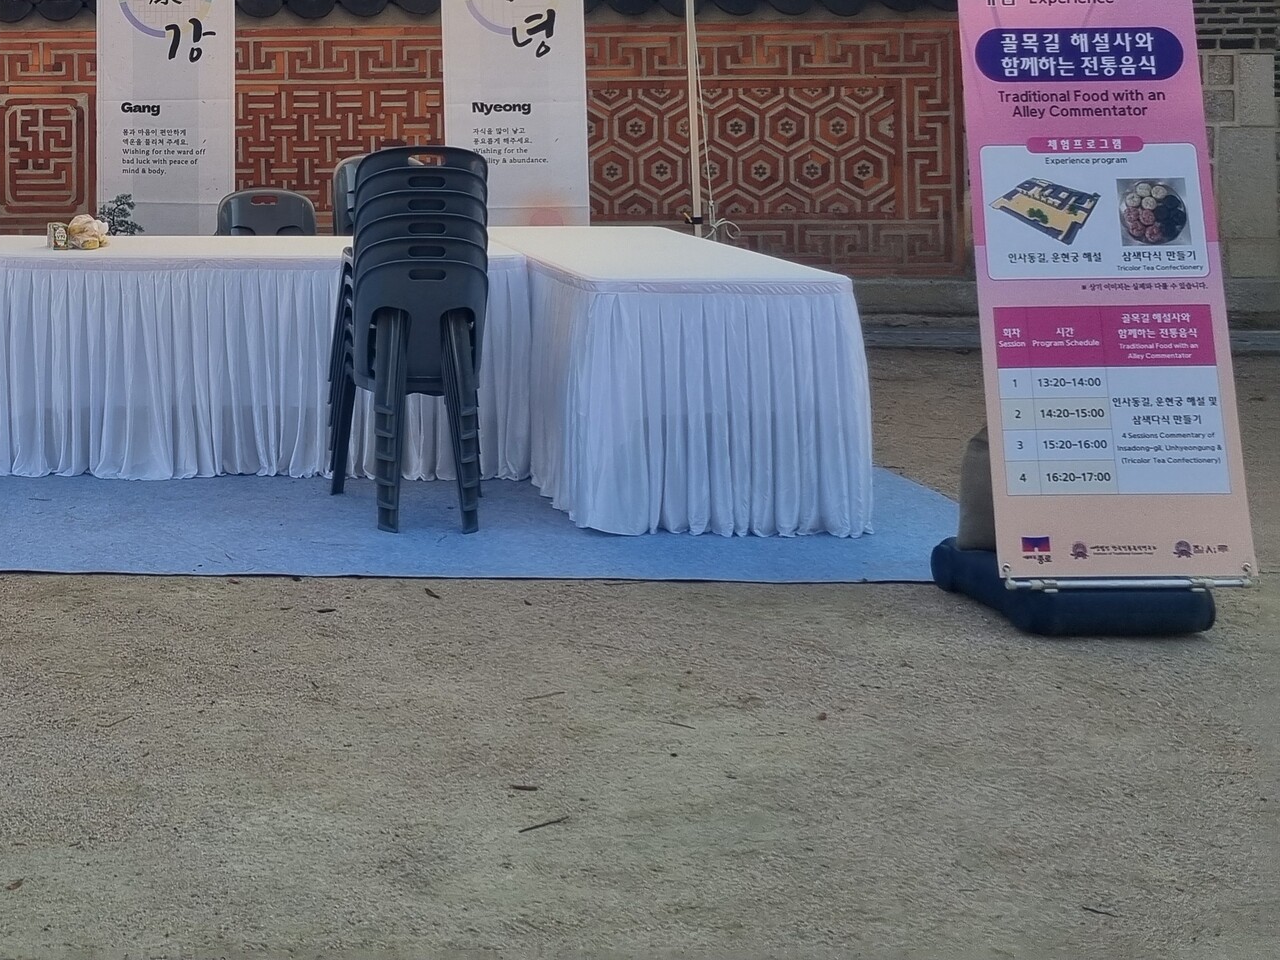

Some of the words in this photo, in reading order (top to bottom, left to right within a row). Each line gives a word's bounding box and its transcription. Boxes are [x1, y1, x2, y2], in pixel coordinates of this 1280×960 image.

[512, 9, 556, 58] 녕
[165, 18, 216, 63] 강
[1000, 34, 1060, 53] 골목길
[1070, 33, 1154, 53] 해설사와
[1001, 57, 1074, 76] 함께하는
[1081, 56, 1156, 75] 전통음식
[998, 91, 1070, 102] Traditional
[1074, 90, 1108, 102] Food
[1114, 90, 1144, 101] with
[1148, 92, 1165, 100] an
[121, 102, 161, 116] Gang
[472, 102, 531, 115] Nyeong
[1013, 106, 1045, 119] Alley
[1049, 105, 1148, 117] Commentator
[1047, 139, 1122, 150] 체험프로그램
[1045, 157, 1089, 166] Experience
[1092, 157, 1128, 166] program
[1122, 251, 1162, 261] 삼색다식
[1166, 250, 1196, 261] 만들기
[1121, 313, 1149, 323] 골목길
[1152, 313, 1190, 323] 해설사와
[1056, 327, 1074, 338] 시간
[1118, 328, 1155, 339] 함께하는
[1159, 328, 1197, 338] 전통음식
[1032, 340, 1064, 348] Program
[1013, 379, 1017, 388] 1
[1015, 409, 1021, 419] 2
[1017, 440, 1023, 450] 3
[1020, 473, 1026, 482] 4
